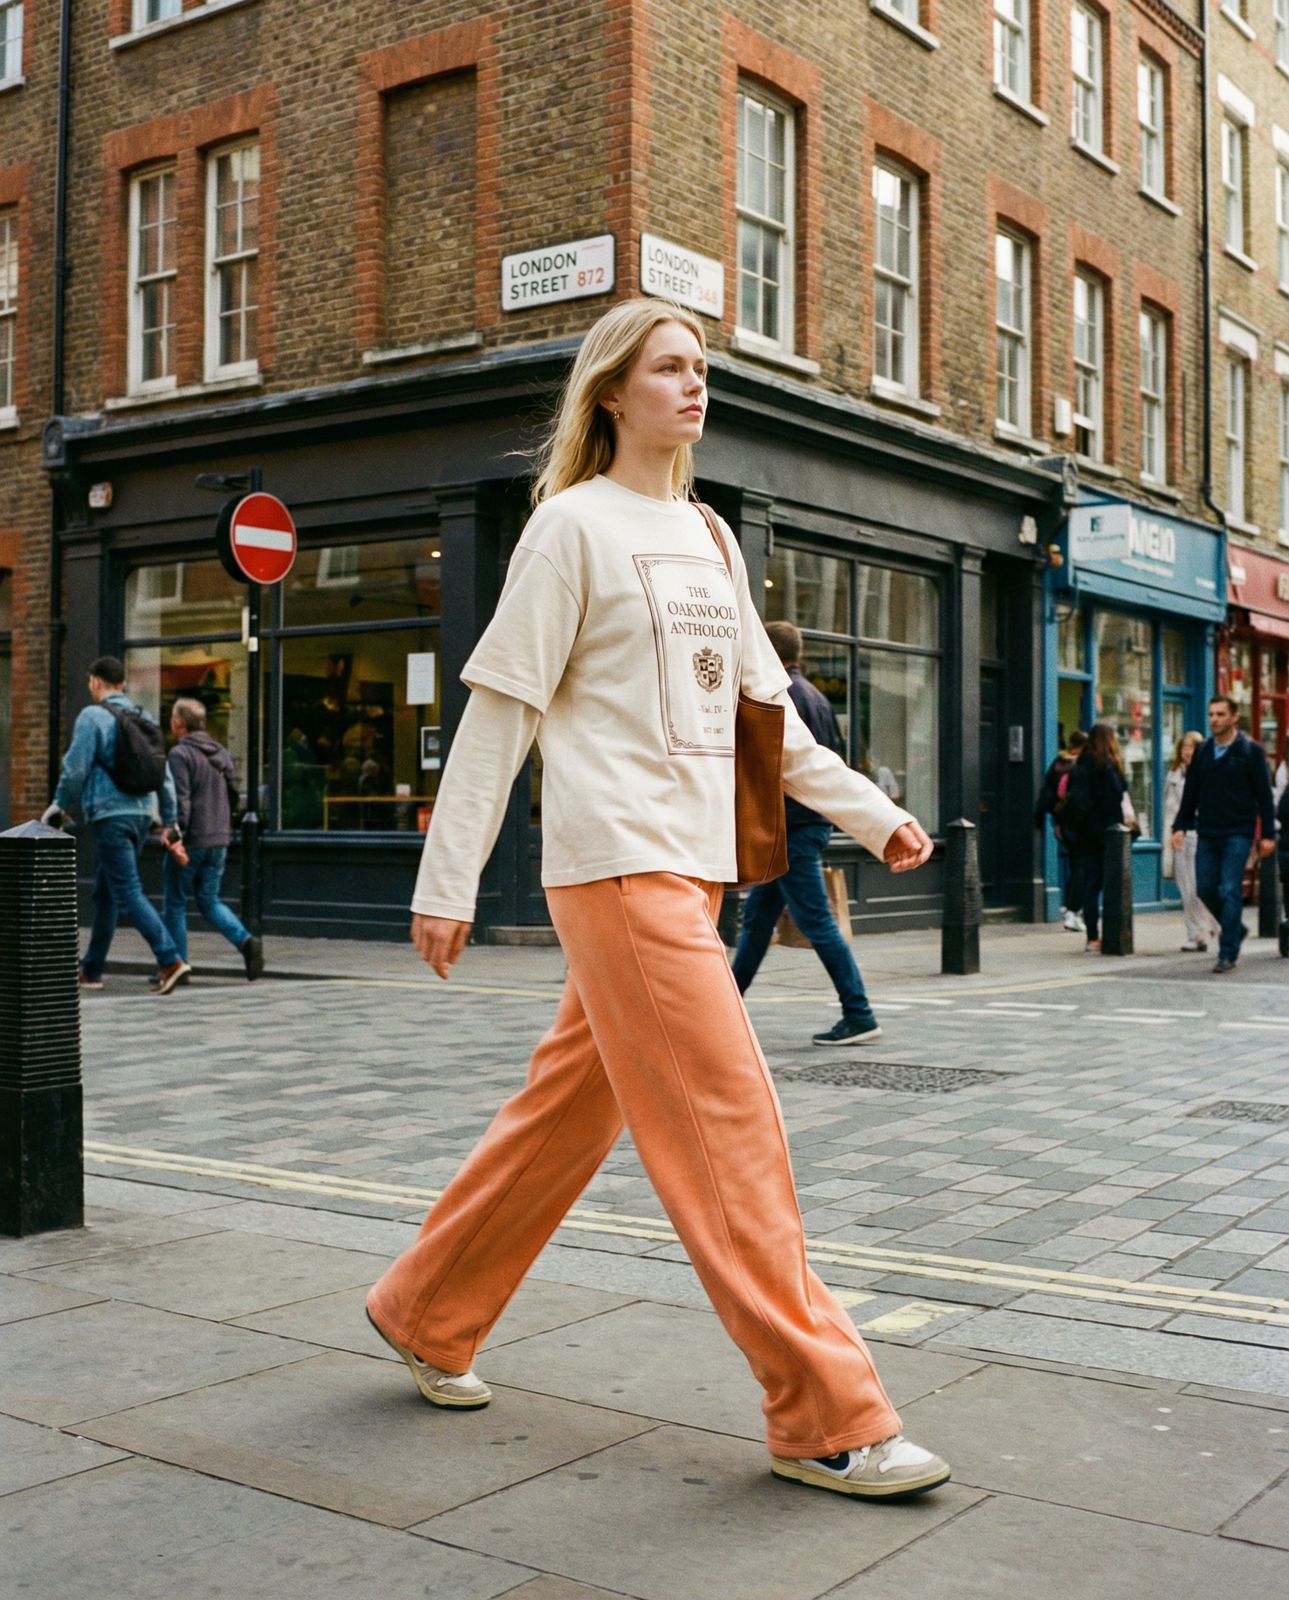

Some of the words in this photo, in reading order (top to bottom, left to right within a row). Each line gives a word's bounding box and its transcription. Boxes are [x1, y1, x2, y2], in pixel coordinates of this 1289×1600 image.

[511, 251, 577, 279] LONDON
[648, 245, 699, 278] LONDON
[510, 274, 569, 300] STREET
[577, 267, 605, 287] 872
[648, 267, 693, 297] STREET
[686, 585, 711, 599] THE
[667, 600, 737, 620] OAKWOOD
[670, 621, 739, 640] ANTHOLOGY
